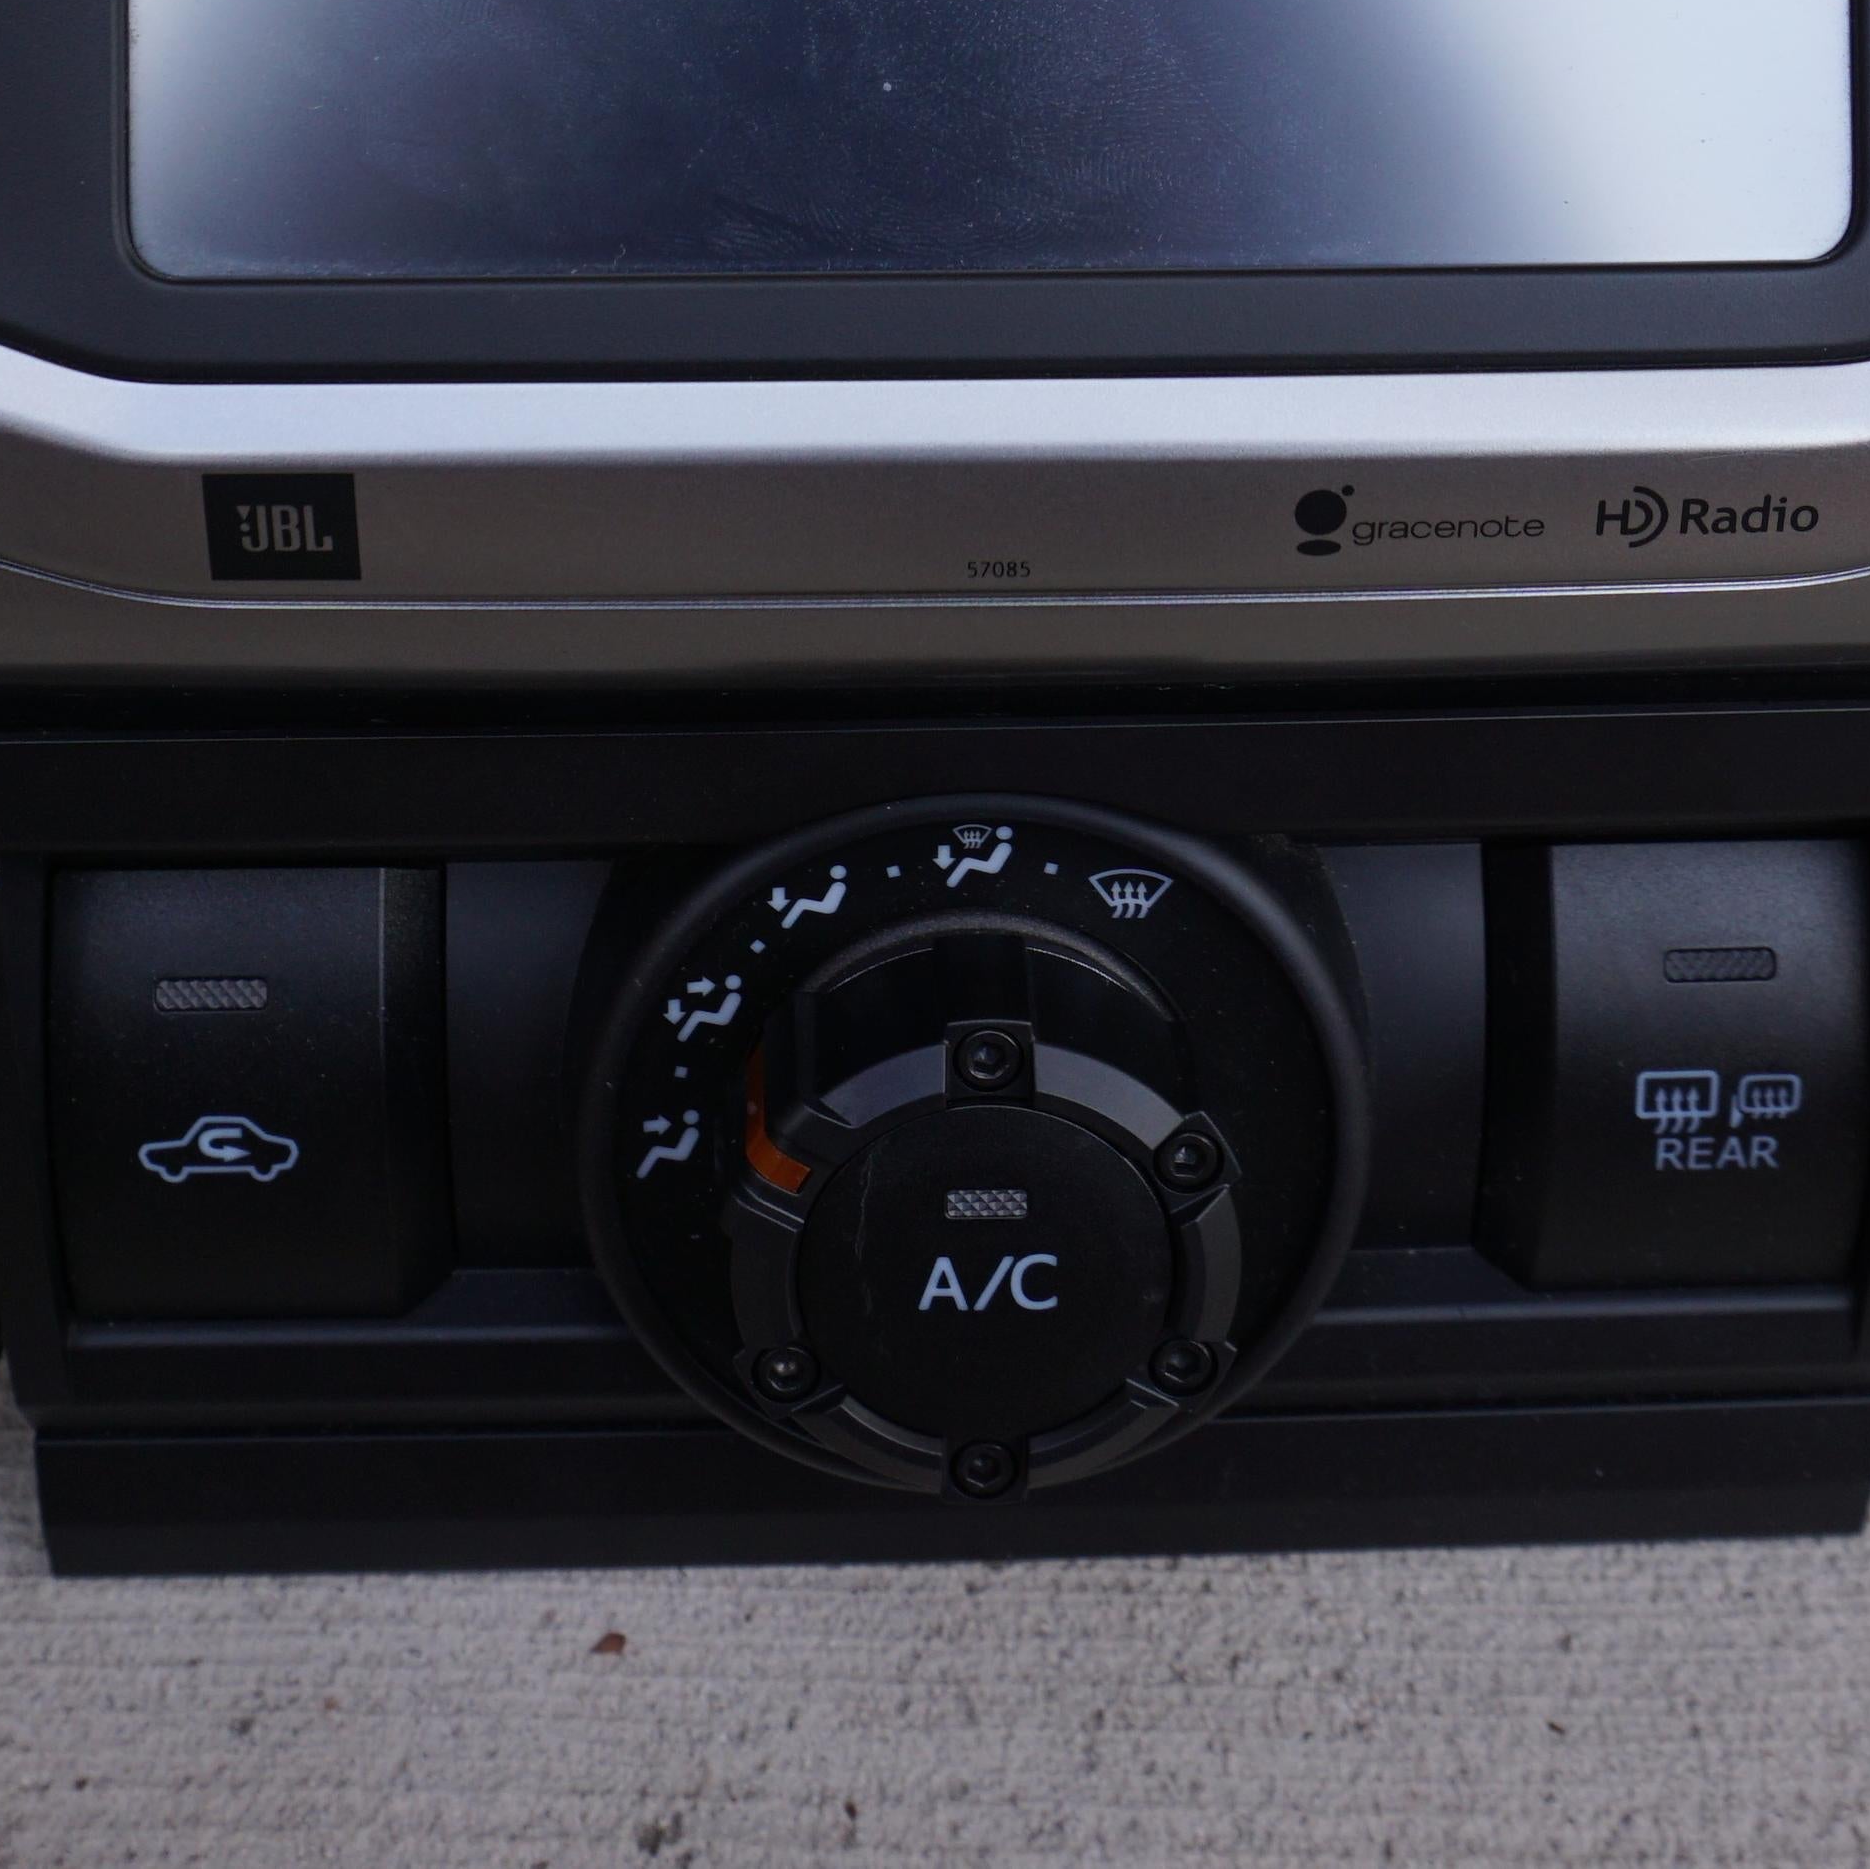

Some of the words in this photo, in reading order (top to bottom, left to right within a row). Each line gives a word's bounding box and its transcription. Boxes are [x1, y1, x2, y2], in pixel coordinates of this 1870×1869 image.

[235, 504, 334, 553] JBL
[1351, 514, 1545, 547] gracenote
[1595, 485, 1670, 548] HD
[1679, 493, 1820, 536] Radio
[967, 561, 1031, 579] 57085
[1654, 1136, 1780, 1171] REAR
[918, 1253, 1059, 1312] A/C
